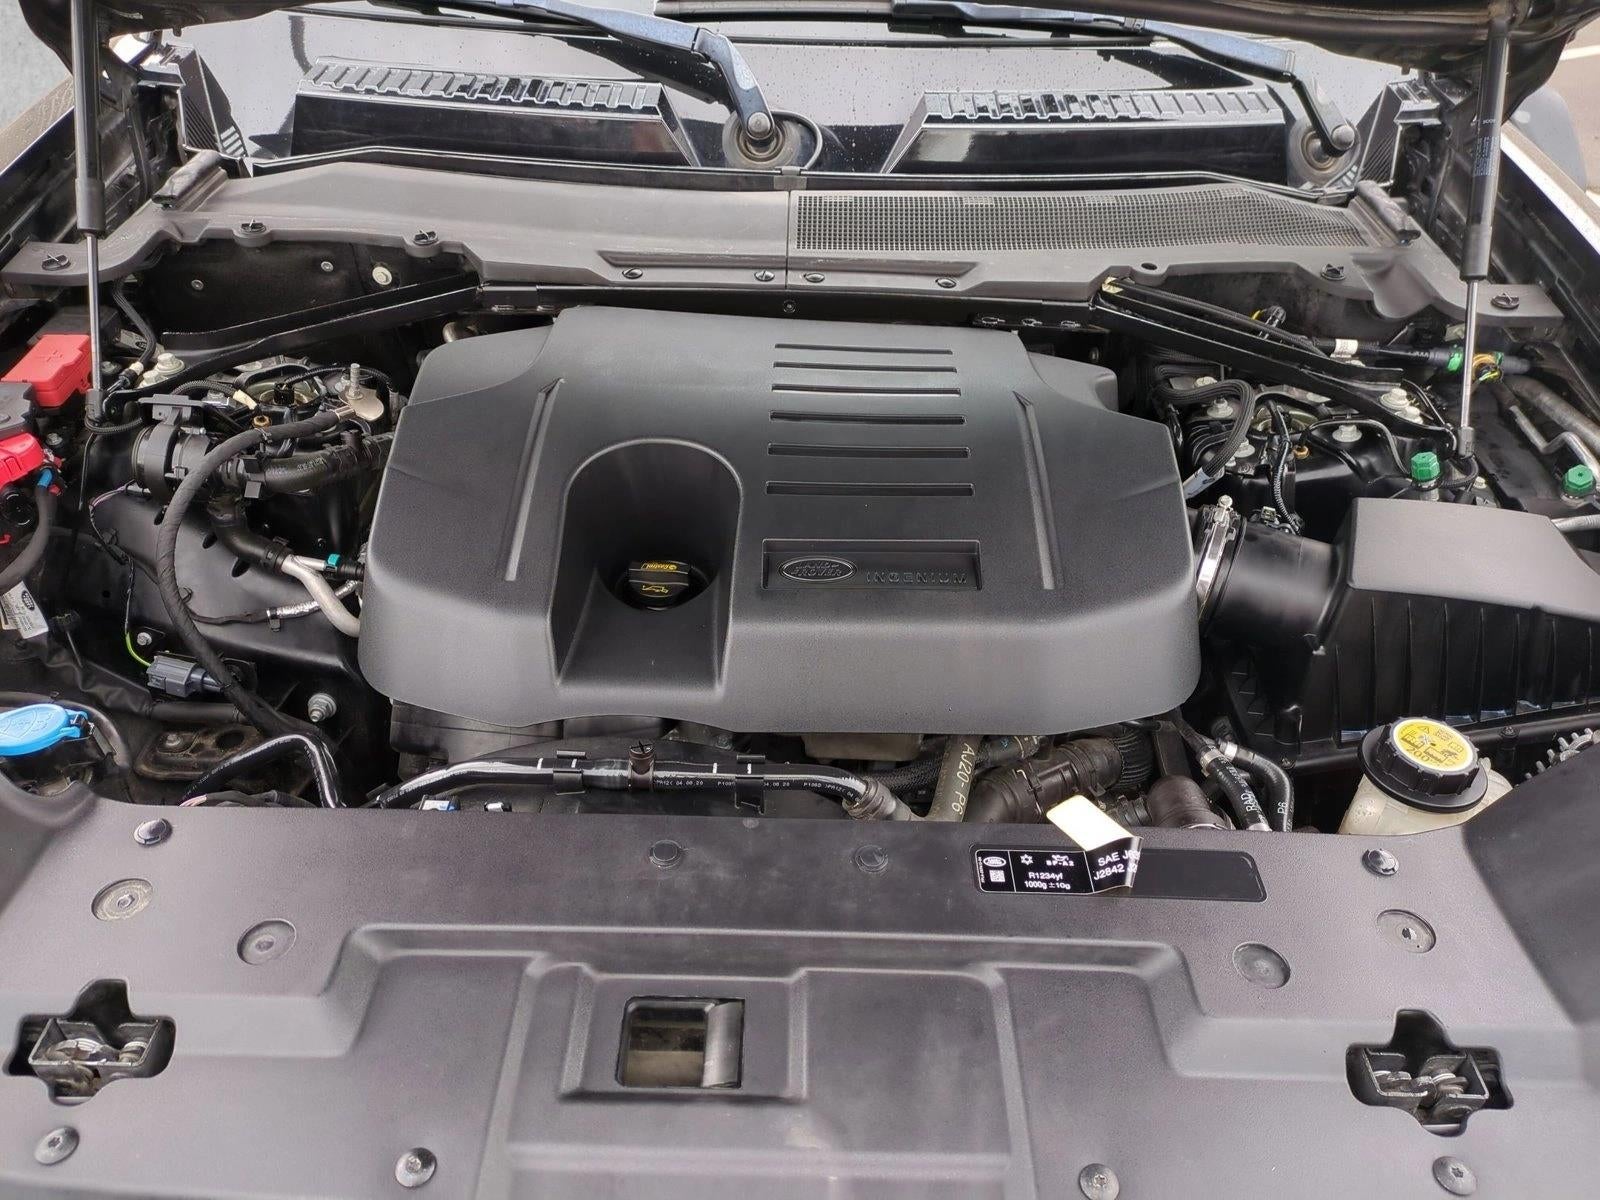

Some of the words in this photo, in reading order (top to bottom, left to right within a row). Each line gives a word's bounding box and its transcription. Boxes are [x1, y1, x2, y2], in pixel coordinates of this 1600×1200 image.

[866, 571, 968, 584] INGENIUM
[951, 742, 975, 815] AJ20-P6
[1097, 851, 1121, 867] SAE
[1028, 871, 1064, 881] R1234yf
[1093, 863, 1126, 881] J2842
[1024, 880, 1048, 890] 1000g
